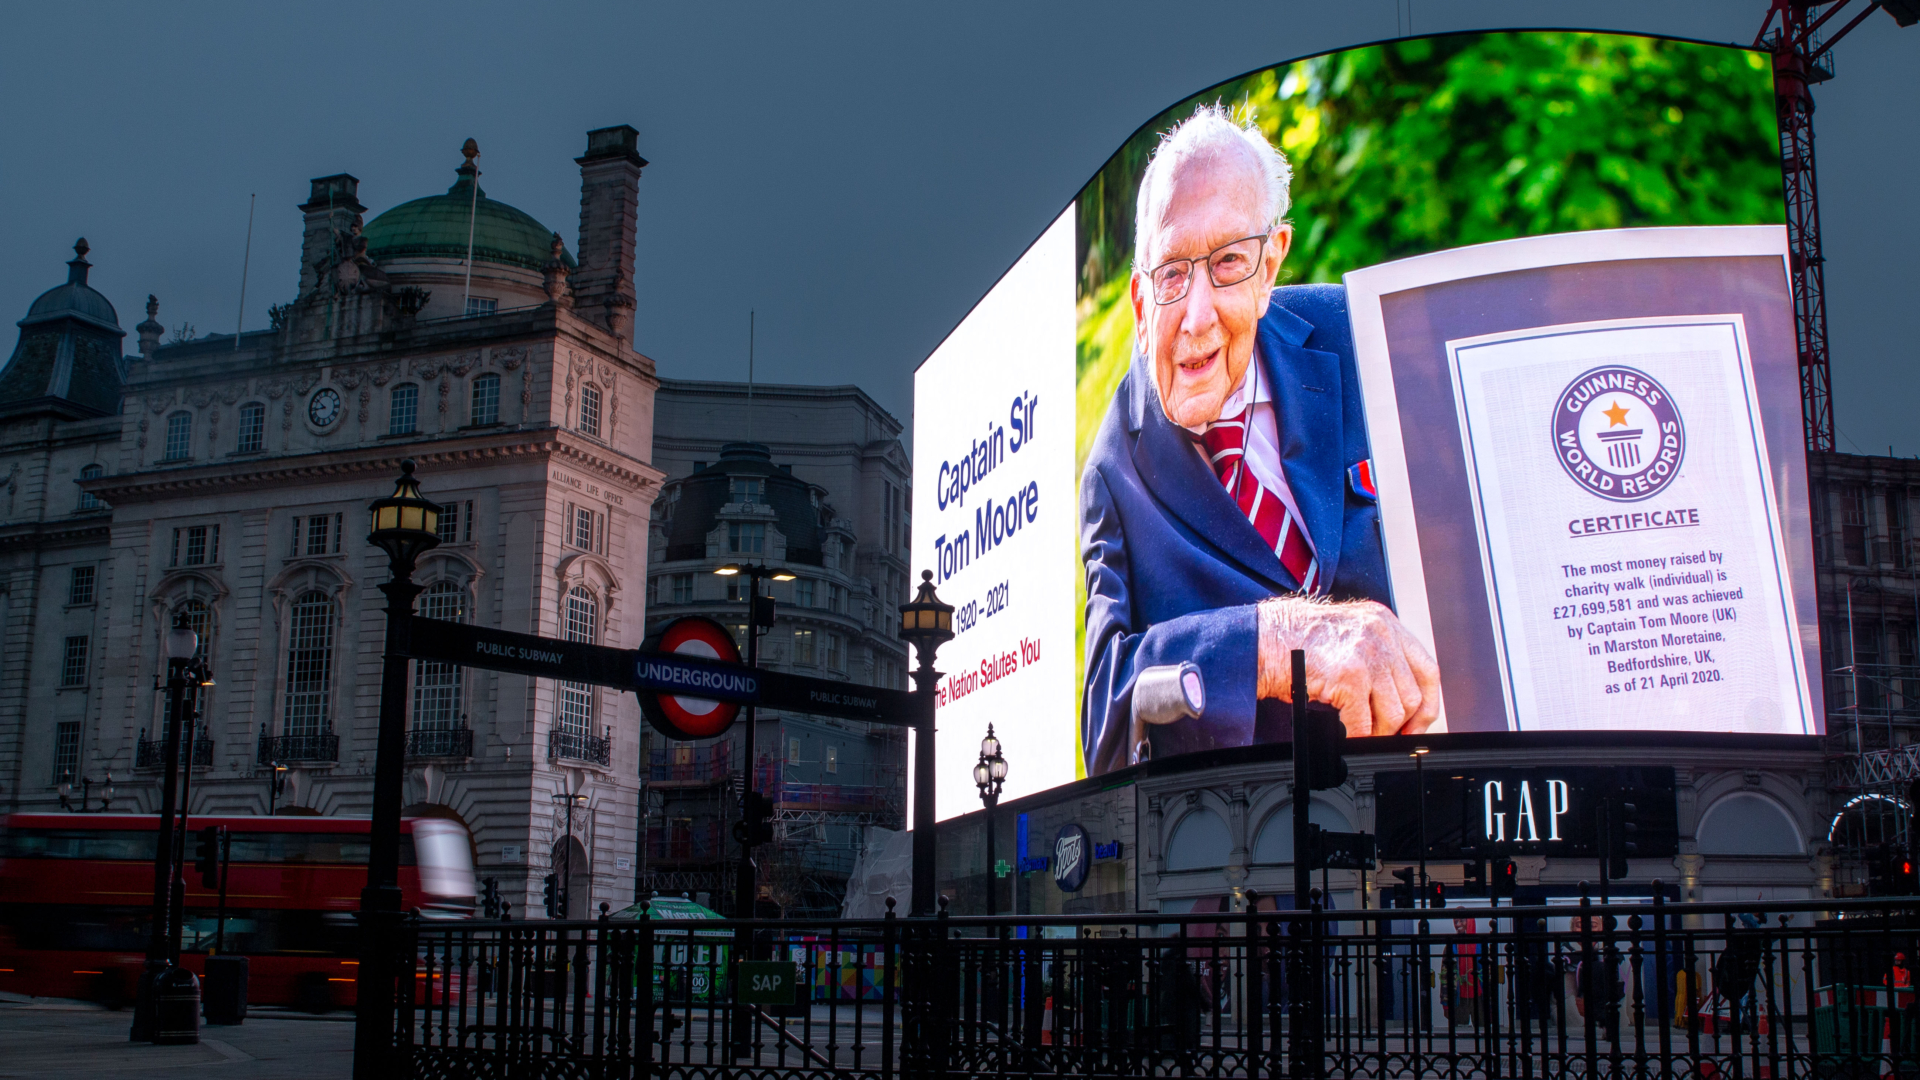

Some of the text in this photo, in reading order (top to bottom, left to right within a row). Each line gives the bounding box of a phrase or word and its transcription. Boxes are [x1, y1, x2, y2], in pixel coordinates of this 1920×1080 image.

[1566, 373, 1662, 414] GUINNESS
[937, 389, 1038, 513] Captain Sir
[1560, 420, 1678, 495] WORLD RECORDS
[552, 470, 623, 506] ALLIANCE LIFE OFFICE
[935, 480, 1039, 585] Tom Moore
[1568, 508, 1700, 535] CERTIFICATE
[1561, 549, 1723, 578] The most money raised by
[1564, 569, 1728, 598] charity walk (individual) is
[955, 599, 977, 635] 1920
[986, 579, 1009, 618] 2021
[1553, 586, 1743, 620] £27,699,581 and was achieved
[1567, 607, 1737, 640] by Captain Tom Moore (UK)
[476, 640, 564, 666] PUBLIC SUBWAY
[1588, 630, 1726, 656] in Marston Moretaine,
[637, 661, 757, 693] UNDERGROUND
[935, 636, 1040, 710] he Nation Salutes You
[1607, 650, 1716, 674] Bedfordshire, UK,
[1605, 669, 1725, 694] as of 21 April 2020.
[810, 690, 877, 709] PUBLIC SUBWAY
[1485, 778, 1570, 842] GAP
[1054, 833, 1082, 881] Boots
[752, 974, 781, 992] SAP
